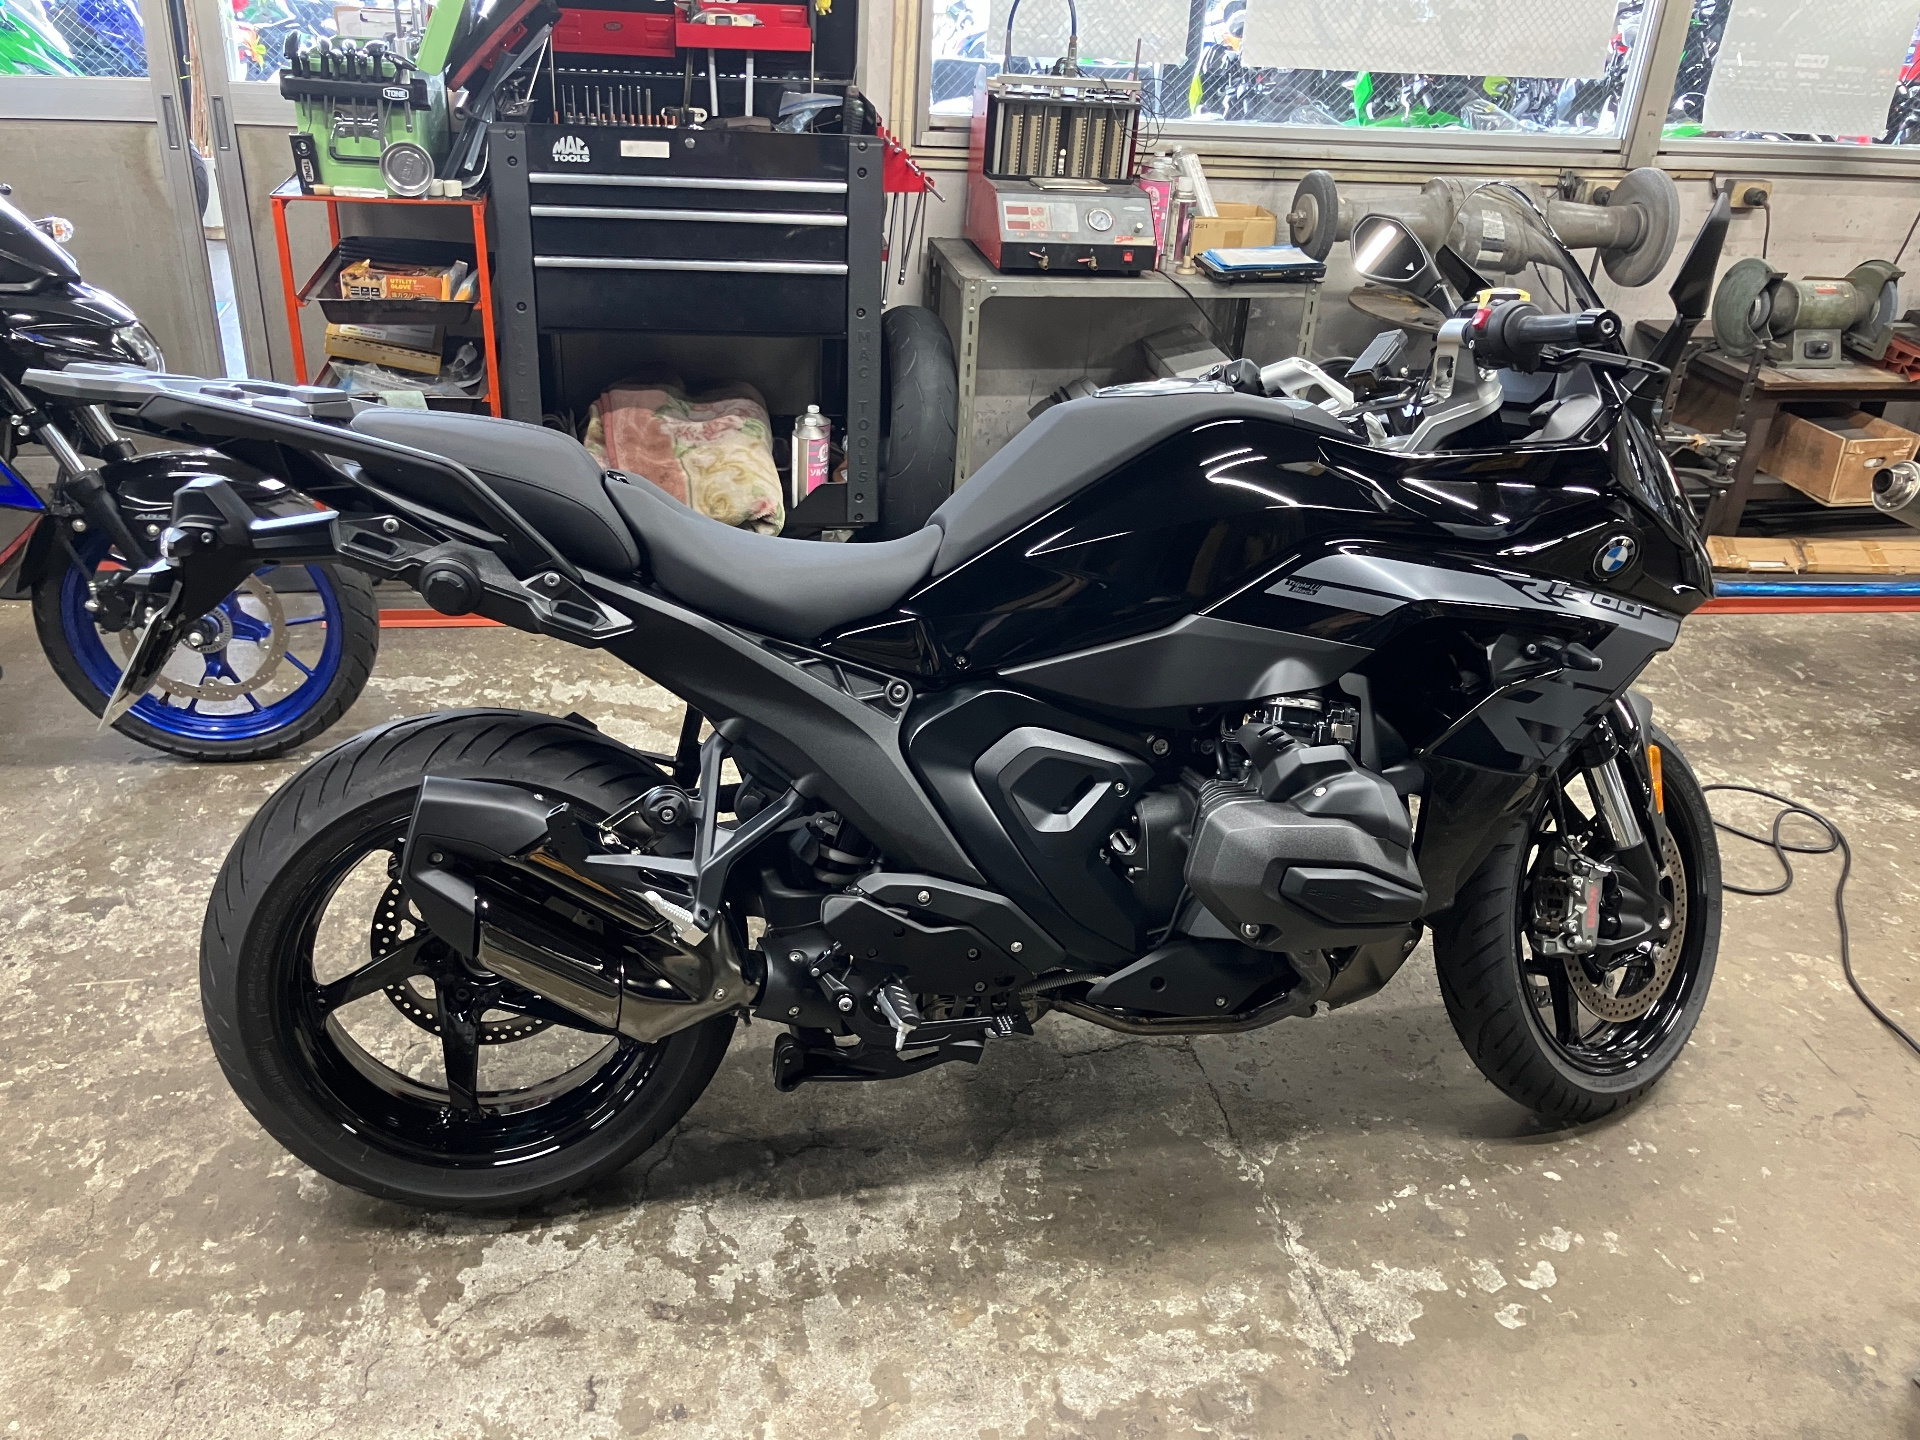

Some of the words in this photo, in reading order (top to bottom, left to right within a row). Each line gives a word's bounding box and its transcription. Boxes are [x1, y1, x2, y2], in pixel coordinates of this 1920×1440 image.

[386, 89, 406, 98] TONE
[552, 135, 590, 155] MAC
[552, 154, 590, 163] TOOLS
[303, 160, 314, 182] TONE
[857, 329, 871, 379] MAC
[857, 400, 871, 483] TOOLS
